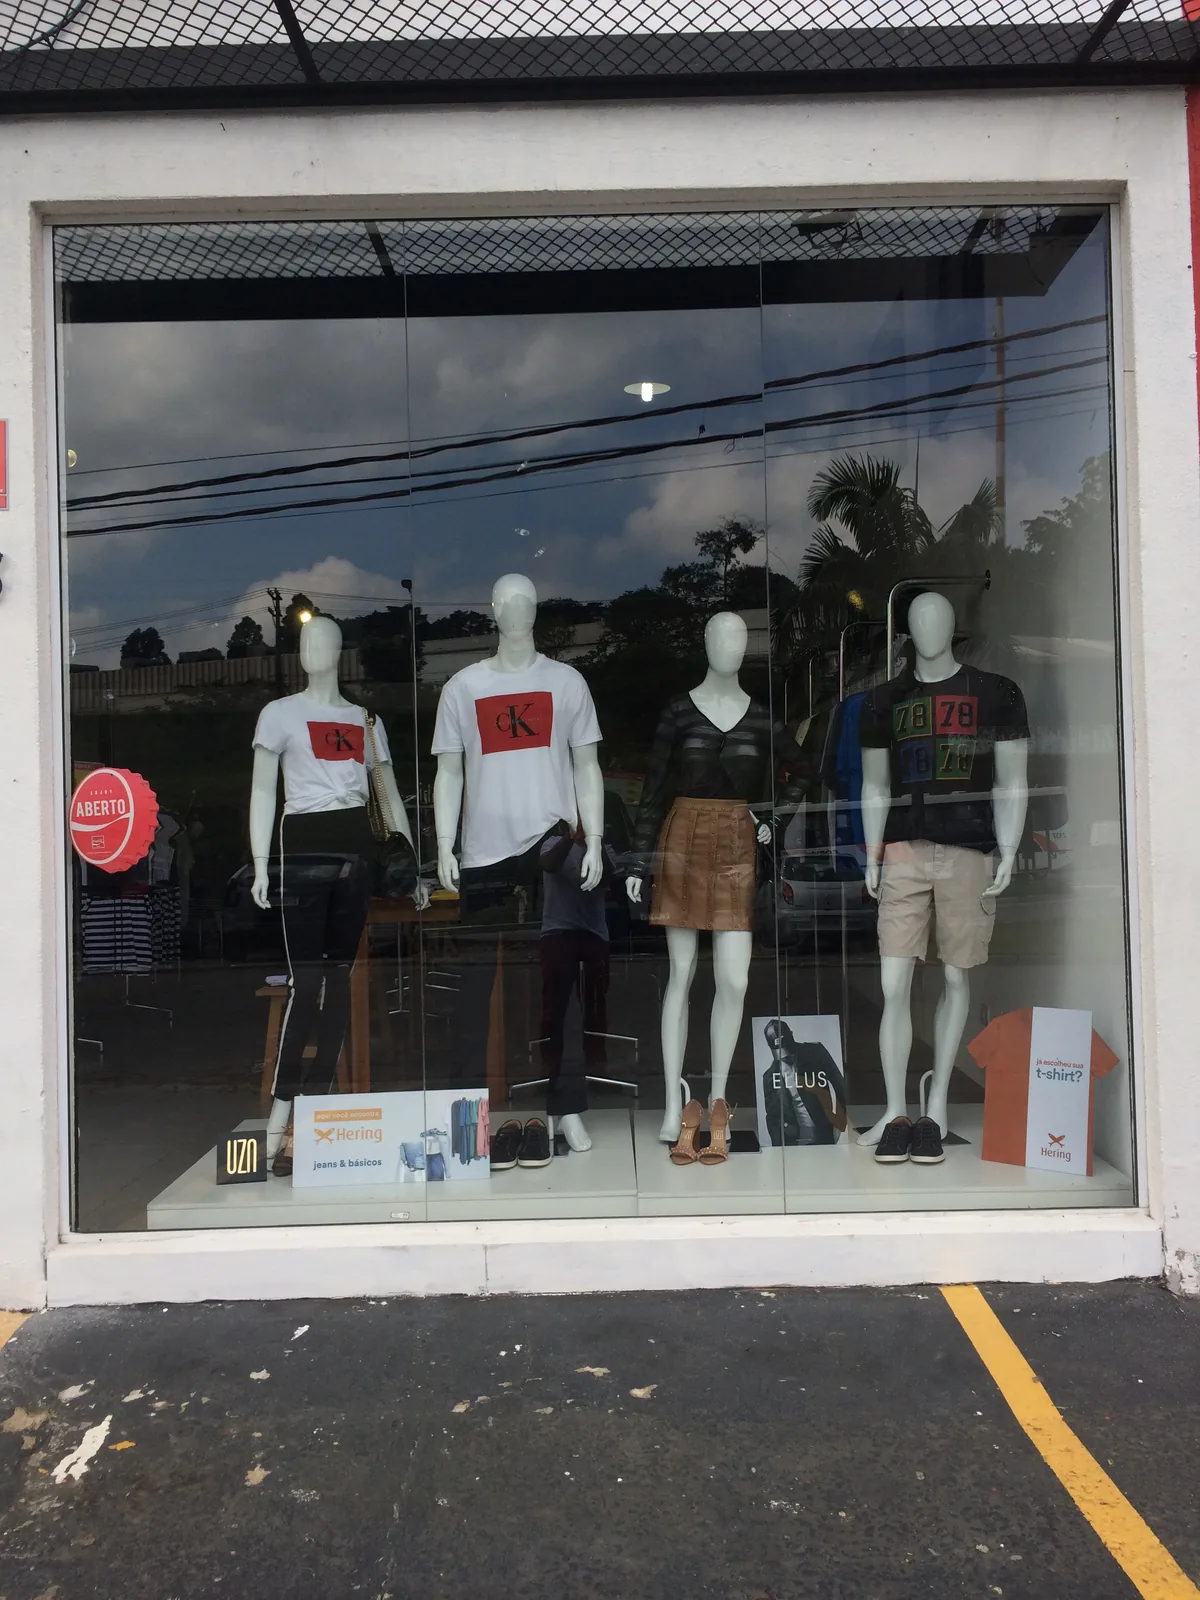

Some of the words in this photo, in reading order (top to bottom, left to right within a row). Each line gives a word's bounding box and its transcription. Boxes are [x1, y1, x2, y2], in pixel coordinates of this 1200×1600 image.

[896, 702, 927, 733] 78
[940, 701, 973, 728] 78
[76, 799, 126, 817] ABERTO
[772, 1071, 827, 1089] ELLUS
[1036, 1067, 1083, 1083] t-shirt?
[336, 1126, 382, 1143] Hering
[1040, 1147, 1072, 1162] Hering
[313, 1160, 338, 1171] jeans
[339, 1159, 346, 1168] &
[348, 1158, 382, 1167] básicos
